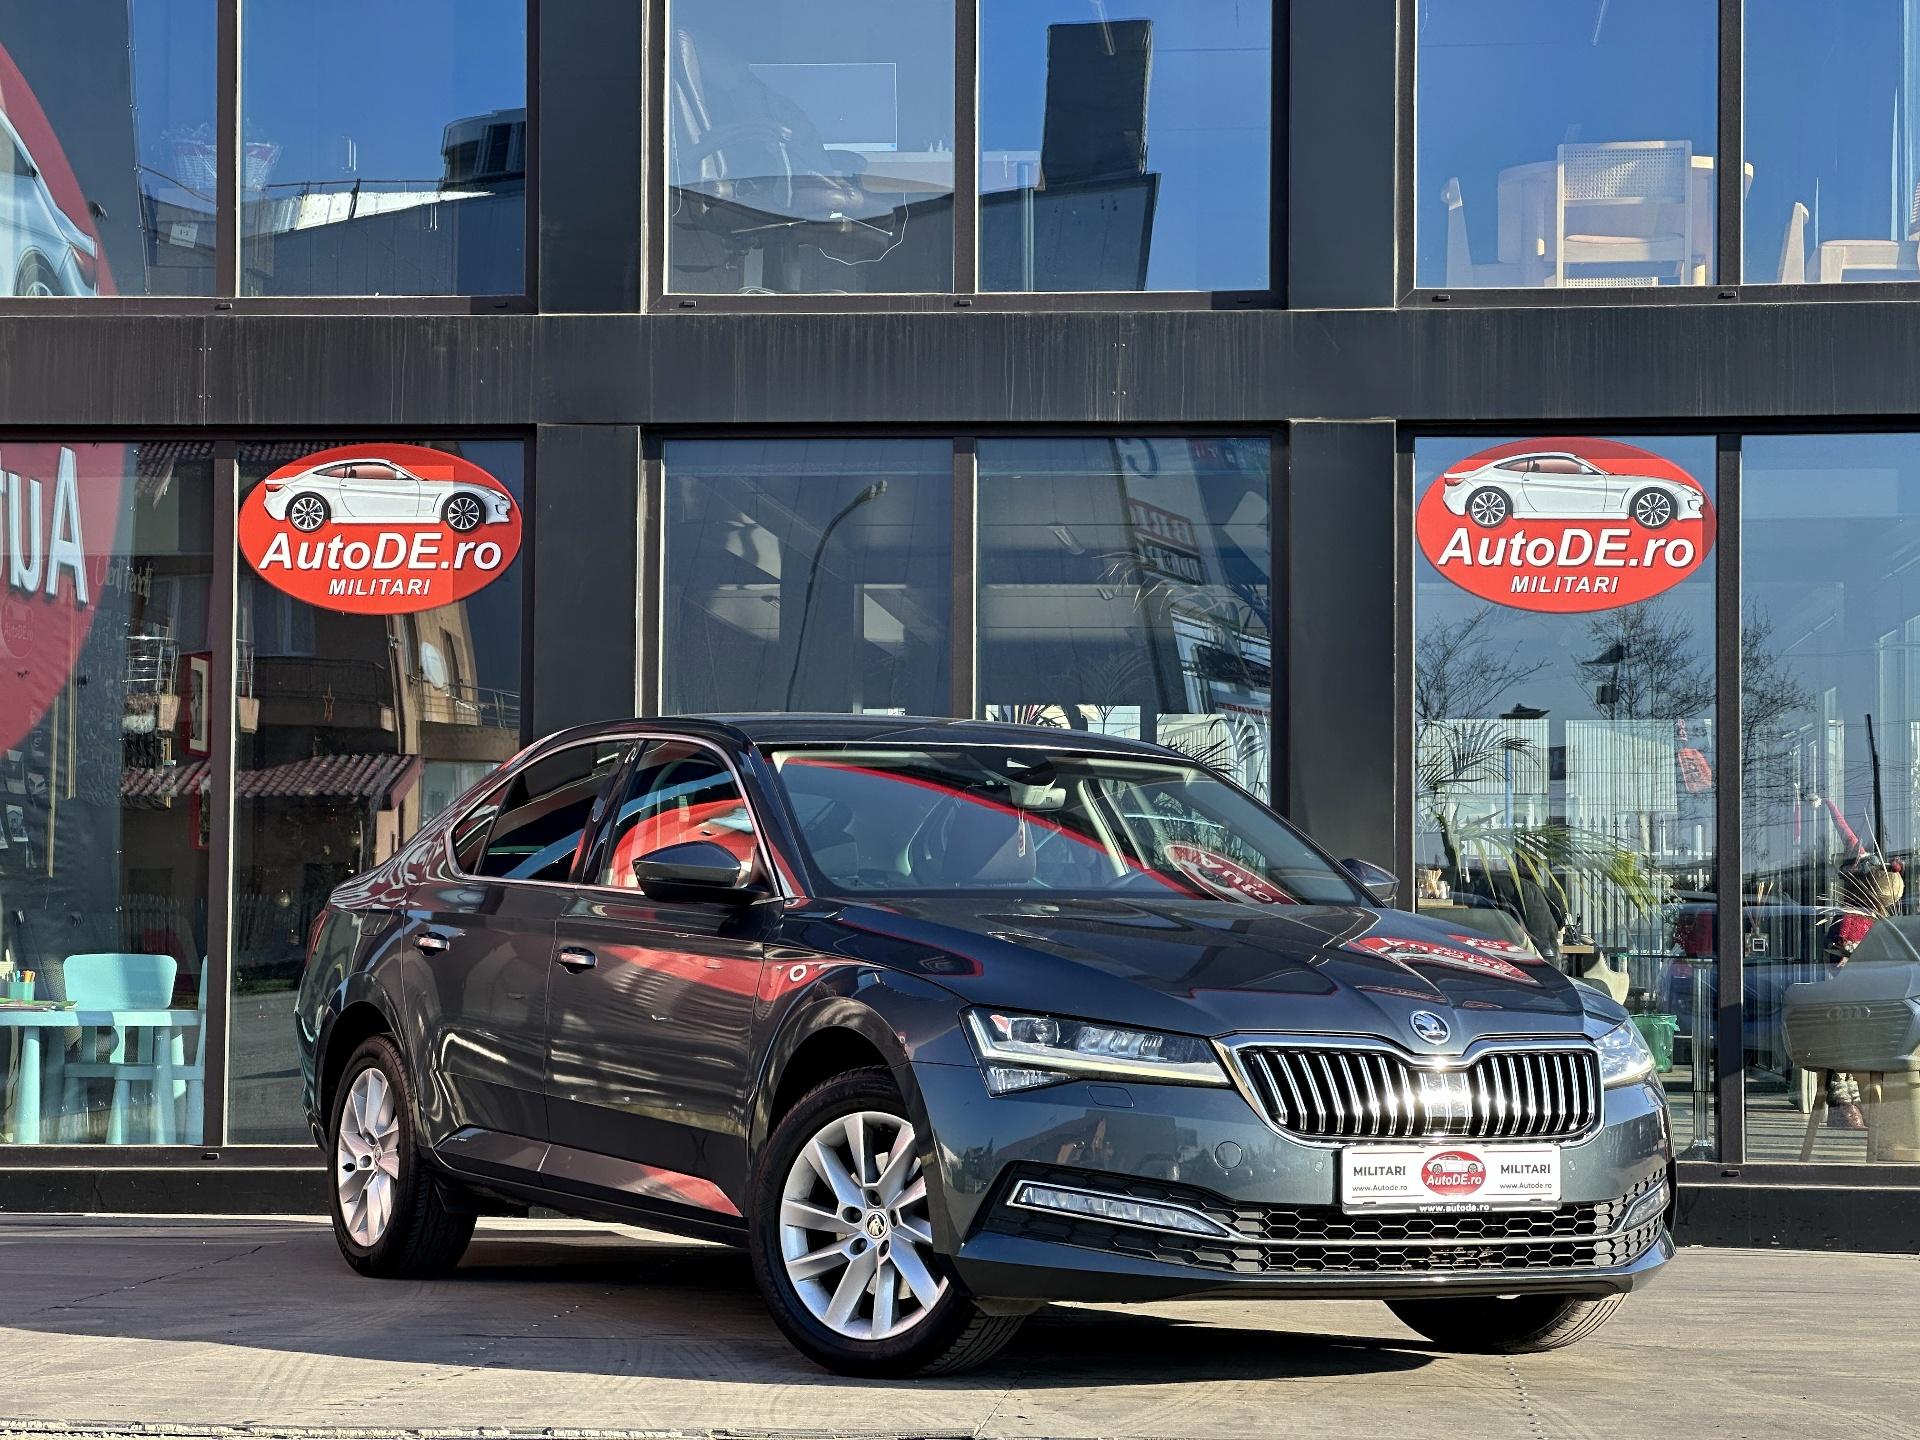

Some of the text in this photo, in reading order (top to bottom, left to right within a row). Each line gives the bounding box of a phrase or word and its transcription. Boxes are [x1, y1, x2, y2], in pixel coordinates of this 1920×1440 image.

[258, 532, 502, 570] AutoDE.ro
[1437, 527, 1696, 568] AutoDE.ro
[328, 578, 431, 596] MILITARI
[1510, 575, 1619, 593] MILITARI
[1353, 1166, 1406, 1176] MILITARI
[1500, 1164, 1551, 1174] MILITARI
[1427, 1174, 1482, 1186] AutoDE.ro
[1352, 1184, 1408, 1192] www.Autode.ro
[1500, 1182, 1552, 1190] www.Autode.ro
[1419, 1204, 1490, 1212] www.autode.ro
